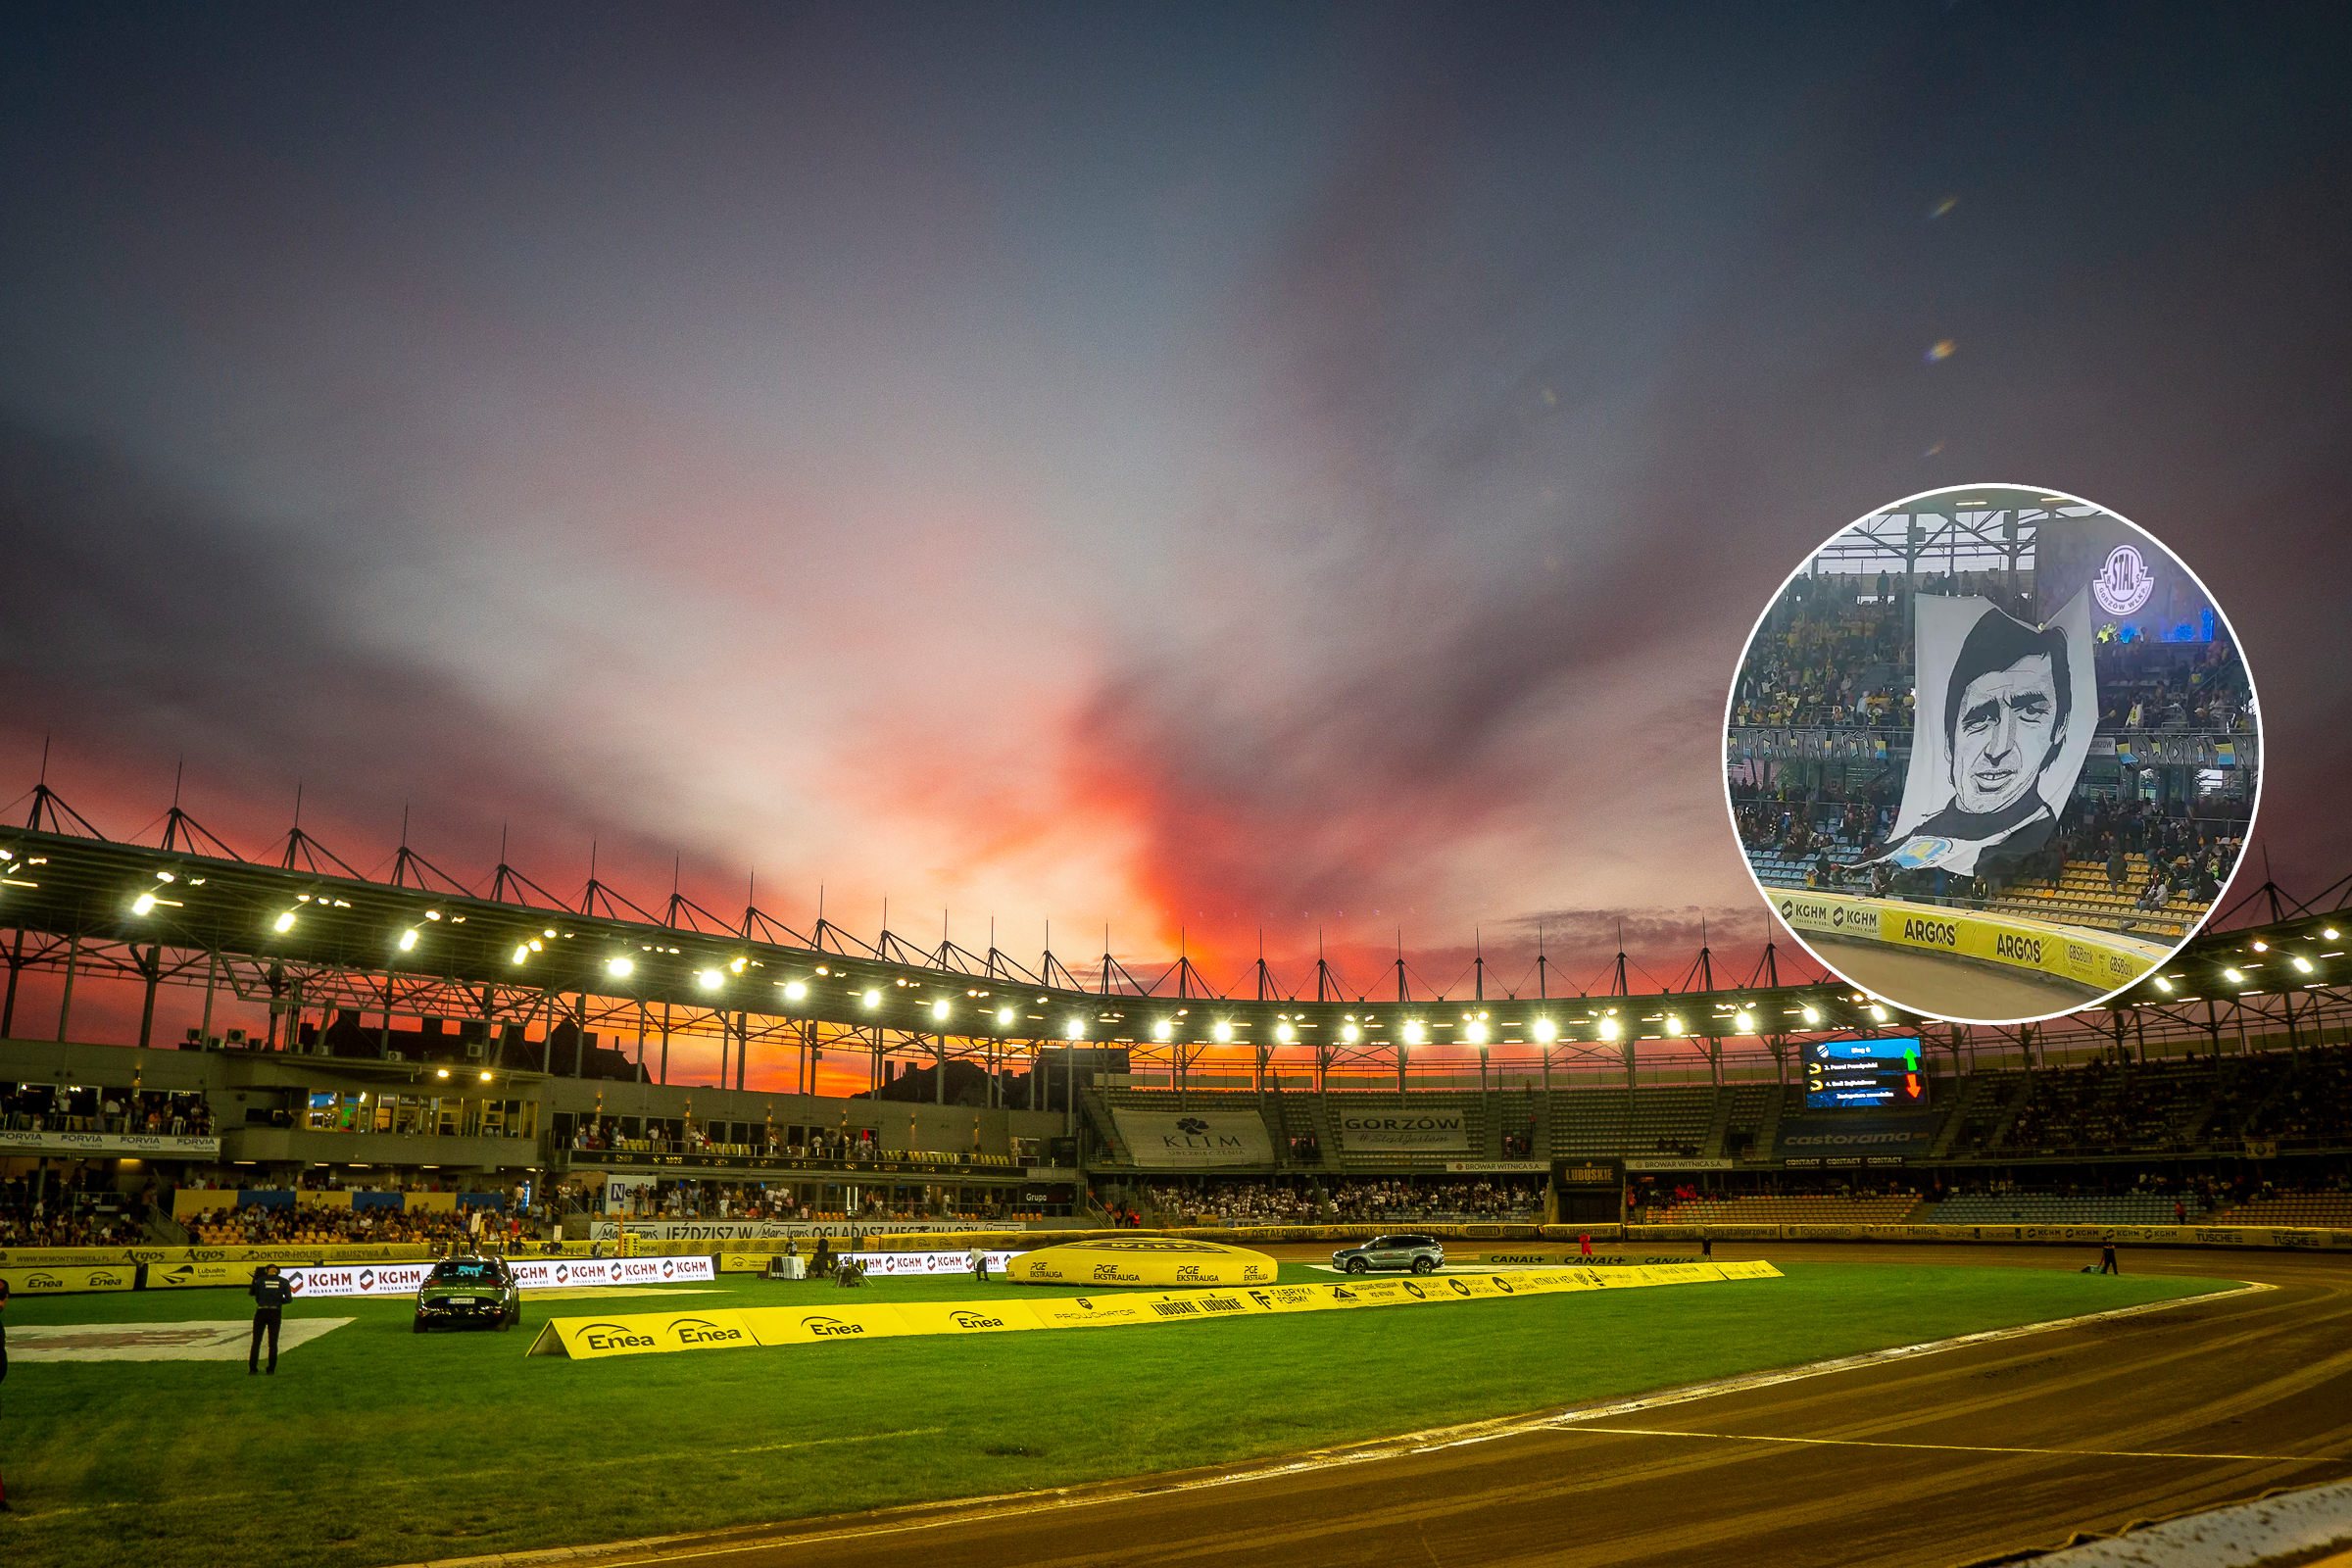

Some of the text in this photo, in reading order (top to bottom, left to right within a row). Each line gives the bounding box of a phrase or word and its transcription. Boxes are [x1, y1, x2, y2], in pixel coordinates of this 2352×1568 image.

[1795, 904, 1827, 920] KGHM
[1847, 909, 1877, 927] KGHM
[1904, 918, 1956, 947] ARGOS
[1996, 933, 2041, 963] ARGOS
[1345, 1115, 1460, 1131] GORZÓW
[61, 1134, 103, 1143] FORVIA
[120, 1136, 161, 1145] FORVIA
[176, 1137, 216, 1146] FORVIA
[1163, 1136, 1243, 1148] KLIM
[1784, 1132, 1911, 1146] castorama
[1565, 1168, 1613, 1181] LUBUSKIE
[1026, 1193, 1048, 1202] Grupa
[737, 1226, 754, 1240] W
[1251, 1228, 1311, 1239] OSTAŁOWSKI
[1346, 1226, 1371, 1237] WDK
[1703, 1226, 1777, 1238] bilety.stalgorzow.pl
[2195, 1233, 2233, 1243] TUSCHE
[2272, 1235, 2310, 1246] TUSCHE
[122, 1249, 166, 1263] Argos
[184, 1248, 226, 1262] Argos
[937, 1256, 962, 1266] KGHM
[1491, 1254, 1544, 1263] CANAL+
[1563, 1255, 1627, 1265] CANAL+
[676, 1261, 708, 1273] KGHM
[897, 1257, 922, 1267] KGHM
[1030, 1262, 1048, 1271] PGE
[512, 1266, 548, 1279] KGHM
[571, 1265, 606, 1277] KGHM
[624, 1263, 658, 1275] KGHM
[1094, 1264, 1118, 1273] PGE
[1177, 1265, 1200, 1274] PGE
[1244, 1265, 1258, 1274] PGE
[89, 1276, 122, 1287] Enea
[308, 1273, 352, 1287] KGHM
[378, 1270, 421, 1284] KGHM
[1094, 1273, 1140, 1282] EKSTRALIGA
[27, 1278, 64, 1289] Enea
[1269, 1287, 1316, 1298] FABRYKA
[1198, 1298, 1246, 1312] LUBUSKIE
[1277, 1296, 1309, 1304] FORMY
[1151, 1300, 1200, 1316] LUBUSKIE
[956, 1317, 1004, 1329] Enea
[809, 1323, 864, 1336] Enea
[587, 1334, 656, 1350] Enea
[678, 1328, 743, 1344] Enea
